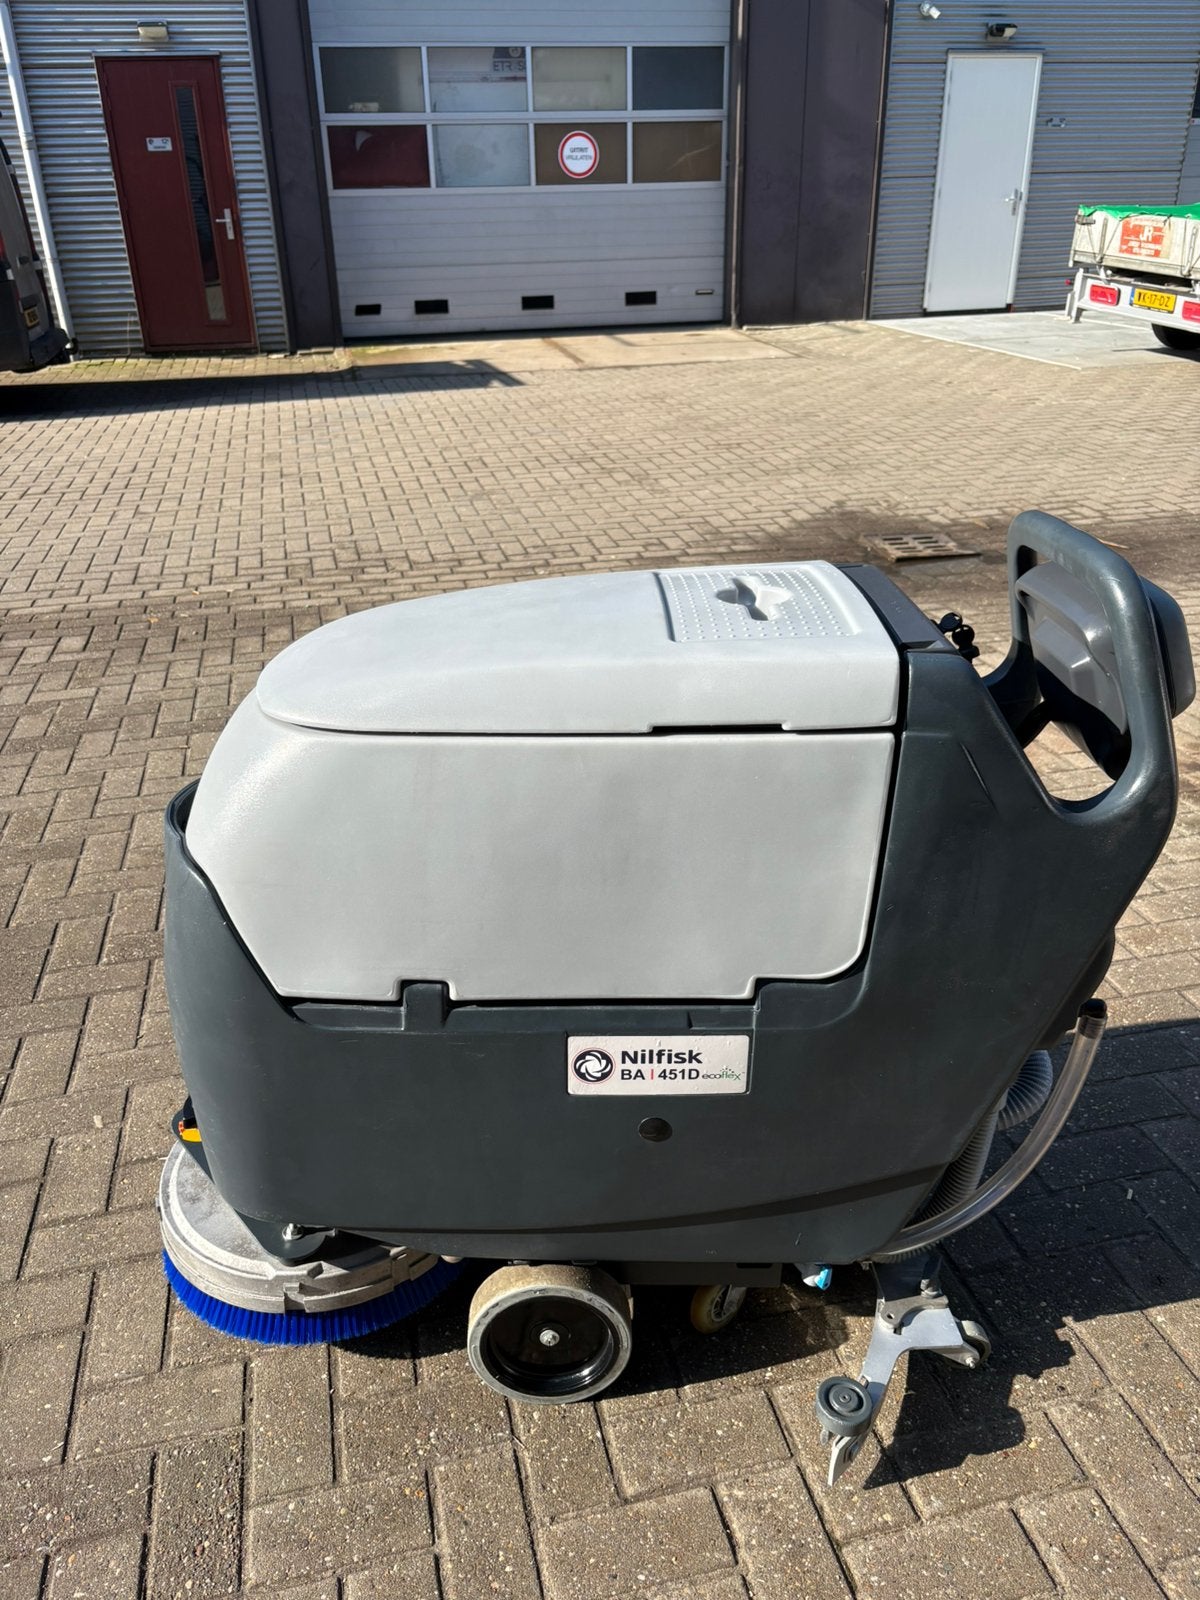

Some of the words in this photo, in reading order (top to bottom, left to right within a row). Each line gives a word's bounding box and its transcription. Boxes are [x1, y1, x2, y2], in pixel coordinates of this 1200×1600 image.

[620, 1049, 703, 1065] Nilfisk
[620, 1068, 646, 1081] BA
[657, 1068, 700, 1081] 451D
[701, 1067, 742, 1082] ecoflex
